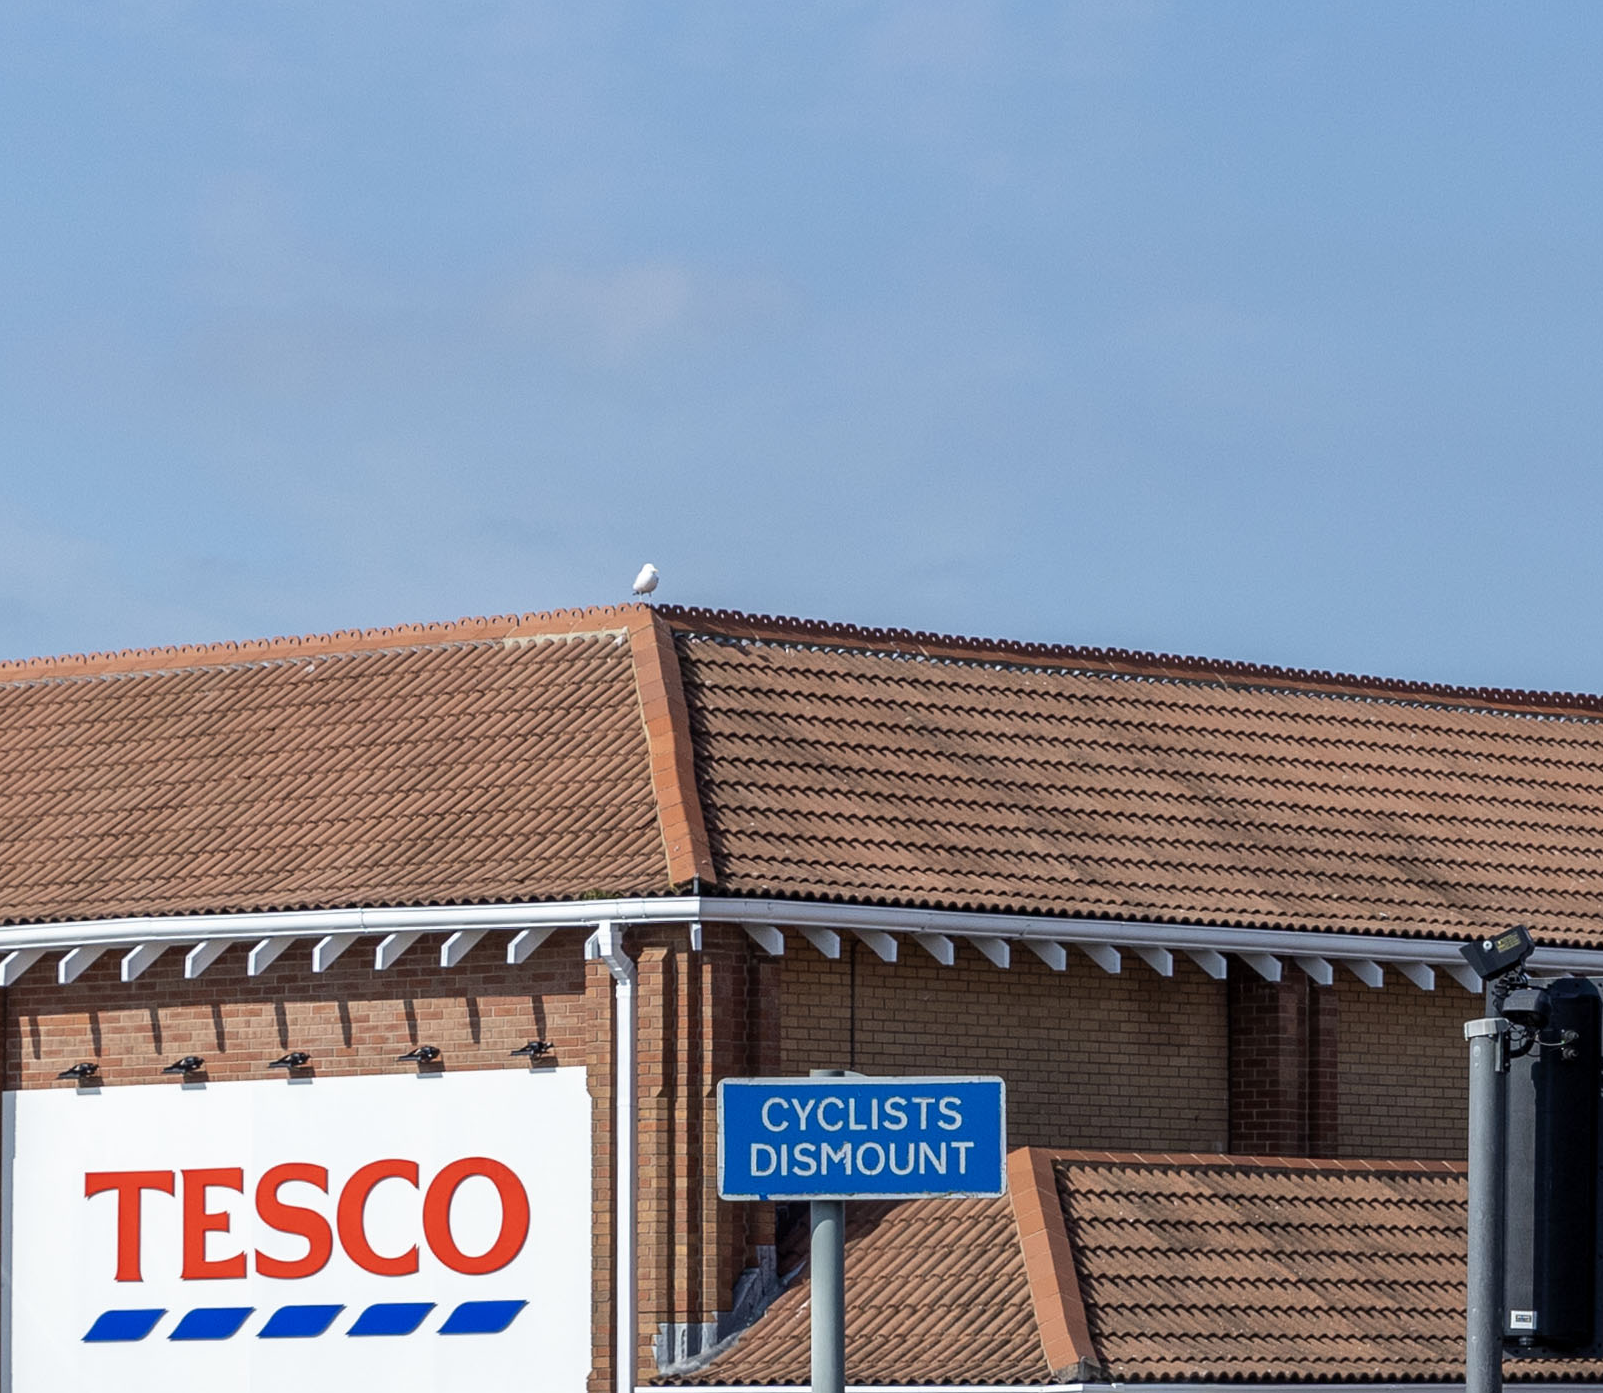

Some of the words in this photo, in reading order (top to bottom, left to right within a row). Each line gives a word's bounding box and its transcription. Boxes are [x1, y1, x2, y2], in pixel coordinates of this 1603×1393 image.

[760, 1095, 964, 1133] CYCLISTS
[749, 1140, 975, 1178] DISMOUNT
[84, 1155, 532, 1284] TESCO
